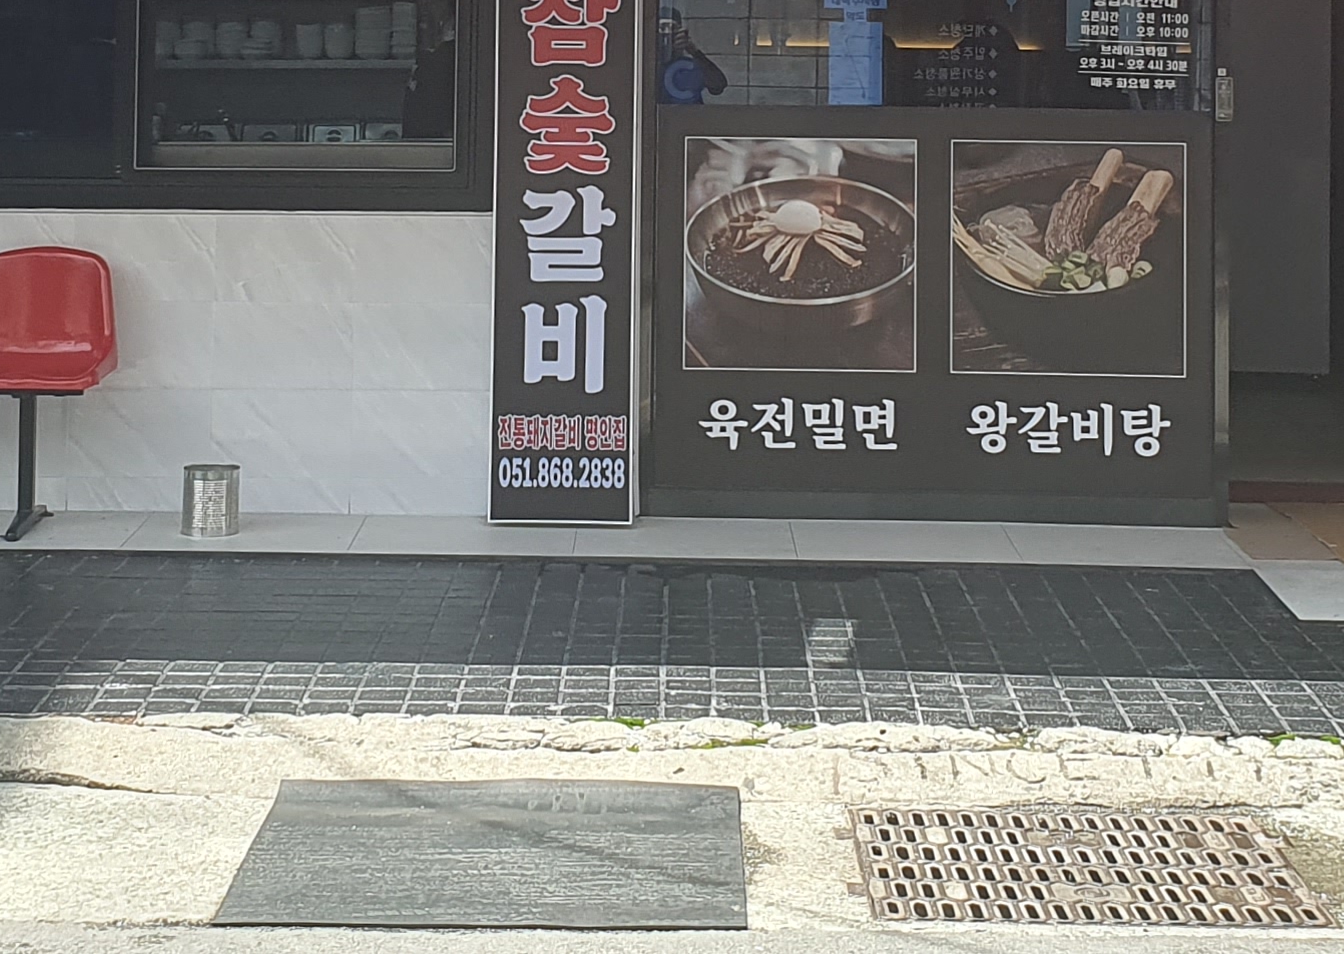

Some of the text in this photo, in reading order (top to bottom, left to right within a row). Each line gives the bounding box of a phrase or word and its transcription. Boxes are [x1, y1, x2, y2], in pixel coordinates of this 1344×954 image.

[1080, 10, 1189, 25] 오픈시간 오전 11:00
[1080, 24, 1189, 38] 마감시간 오후 10:00
[1100, 44, 1168, 57] 브레이크타임
[1079, 57, 1098, 69] 오후
[1100, 58, 1115, 69] 3시
[1126, 59, 1145, 70] 오후
[1147, 60, 1163, 71] 4시
[1166, 60, 1188, 72] 30분
[1090, 77, 1177, 90] 매주 화요일 휴무
[498, 414, 627, 452] 전통돼지갈비 명인집
[698, 397, 1172, 458] 육전밀면 왕갈비탕
[498, 456, 625, 489] 051.868.2838
